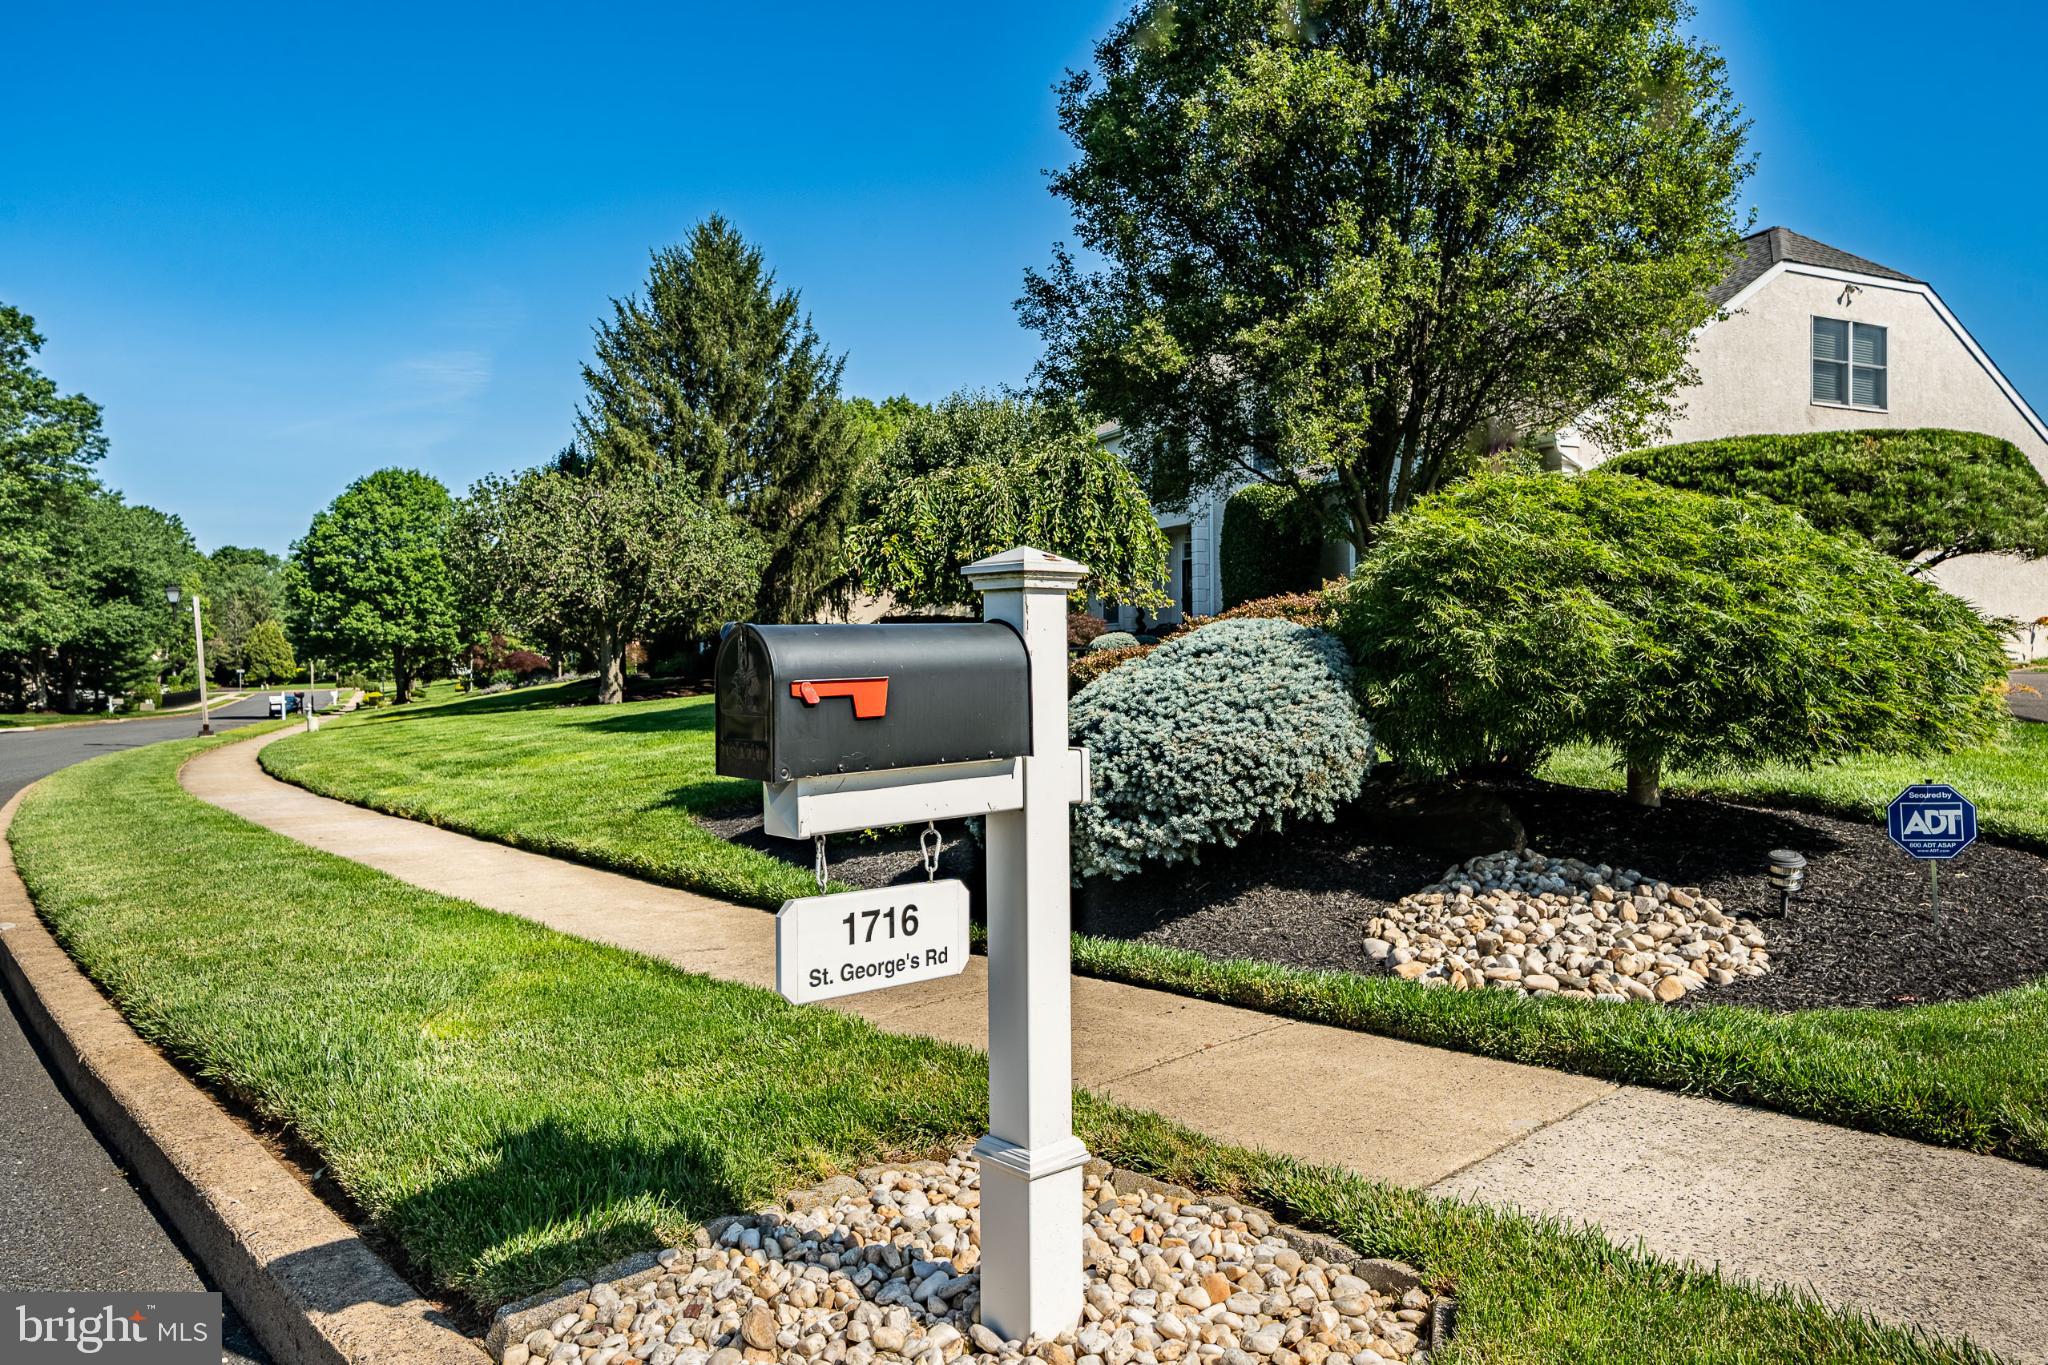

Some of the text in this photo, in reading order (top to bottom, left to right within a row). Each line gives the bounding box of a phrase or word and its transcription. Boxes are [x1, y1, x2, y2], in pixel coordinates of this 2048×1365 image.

[1903, 809, 1962, 835] ADT
[842, 903, 919, 945] 1716
[809, 946, 948, 988] St. George's Rd
